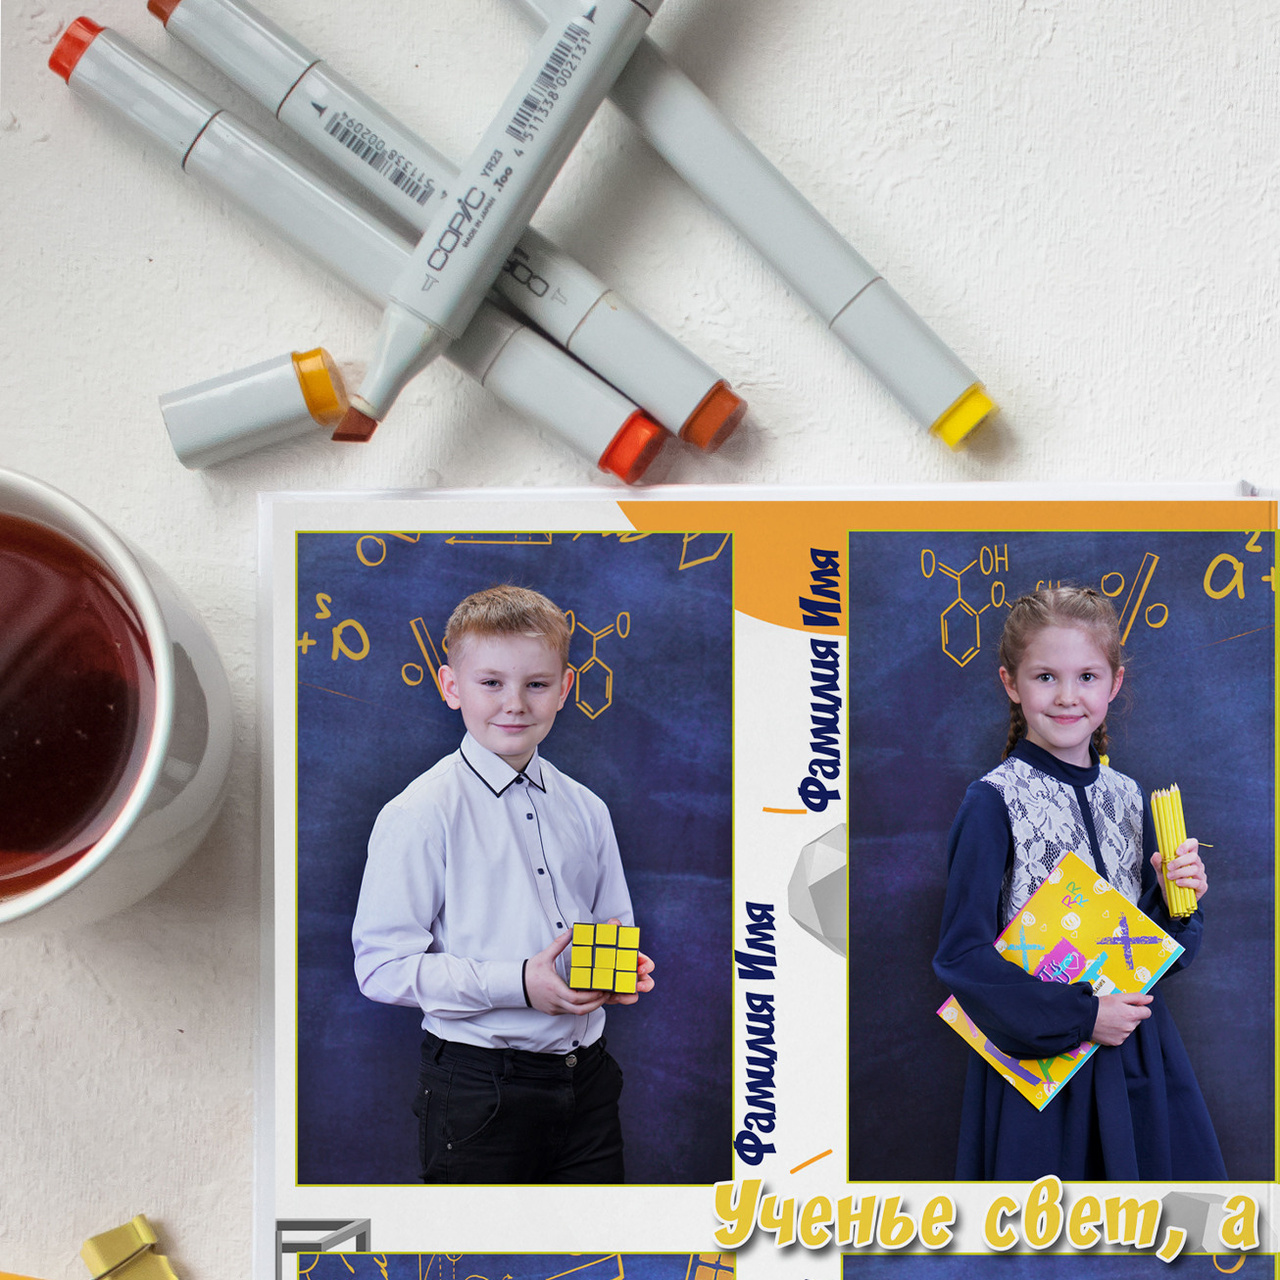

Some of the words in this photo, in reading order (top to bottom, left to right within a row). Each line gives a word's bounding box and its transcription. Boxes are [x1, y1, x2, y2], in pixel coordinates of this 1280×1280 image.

[522, 89, 560, 142] 511338
[555, 36, 592, 88] 002131
[339, 111, 386, 152] 002094
[387, 149, 434, 190] 511338
[480, 149, 504, 178] YR23
[461, 227, 478, 248] MADE
[480, 196, 496, 221] JAPAN
[799, 548, 842, 627] Имя
[797, 638, 842, 813] Фамилия
[735, 901, 778, 980] Имя
[734, 991, 778, 1166] Фамилия
[713, 1178, 954, 1247] Ученье
[983, 1177, 1185, 1261] свет,
[1220, 1194, 1257, 1249] а
